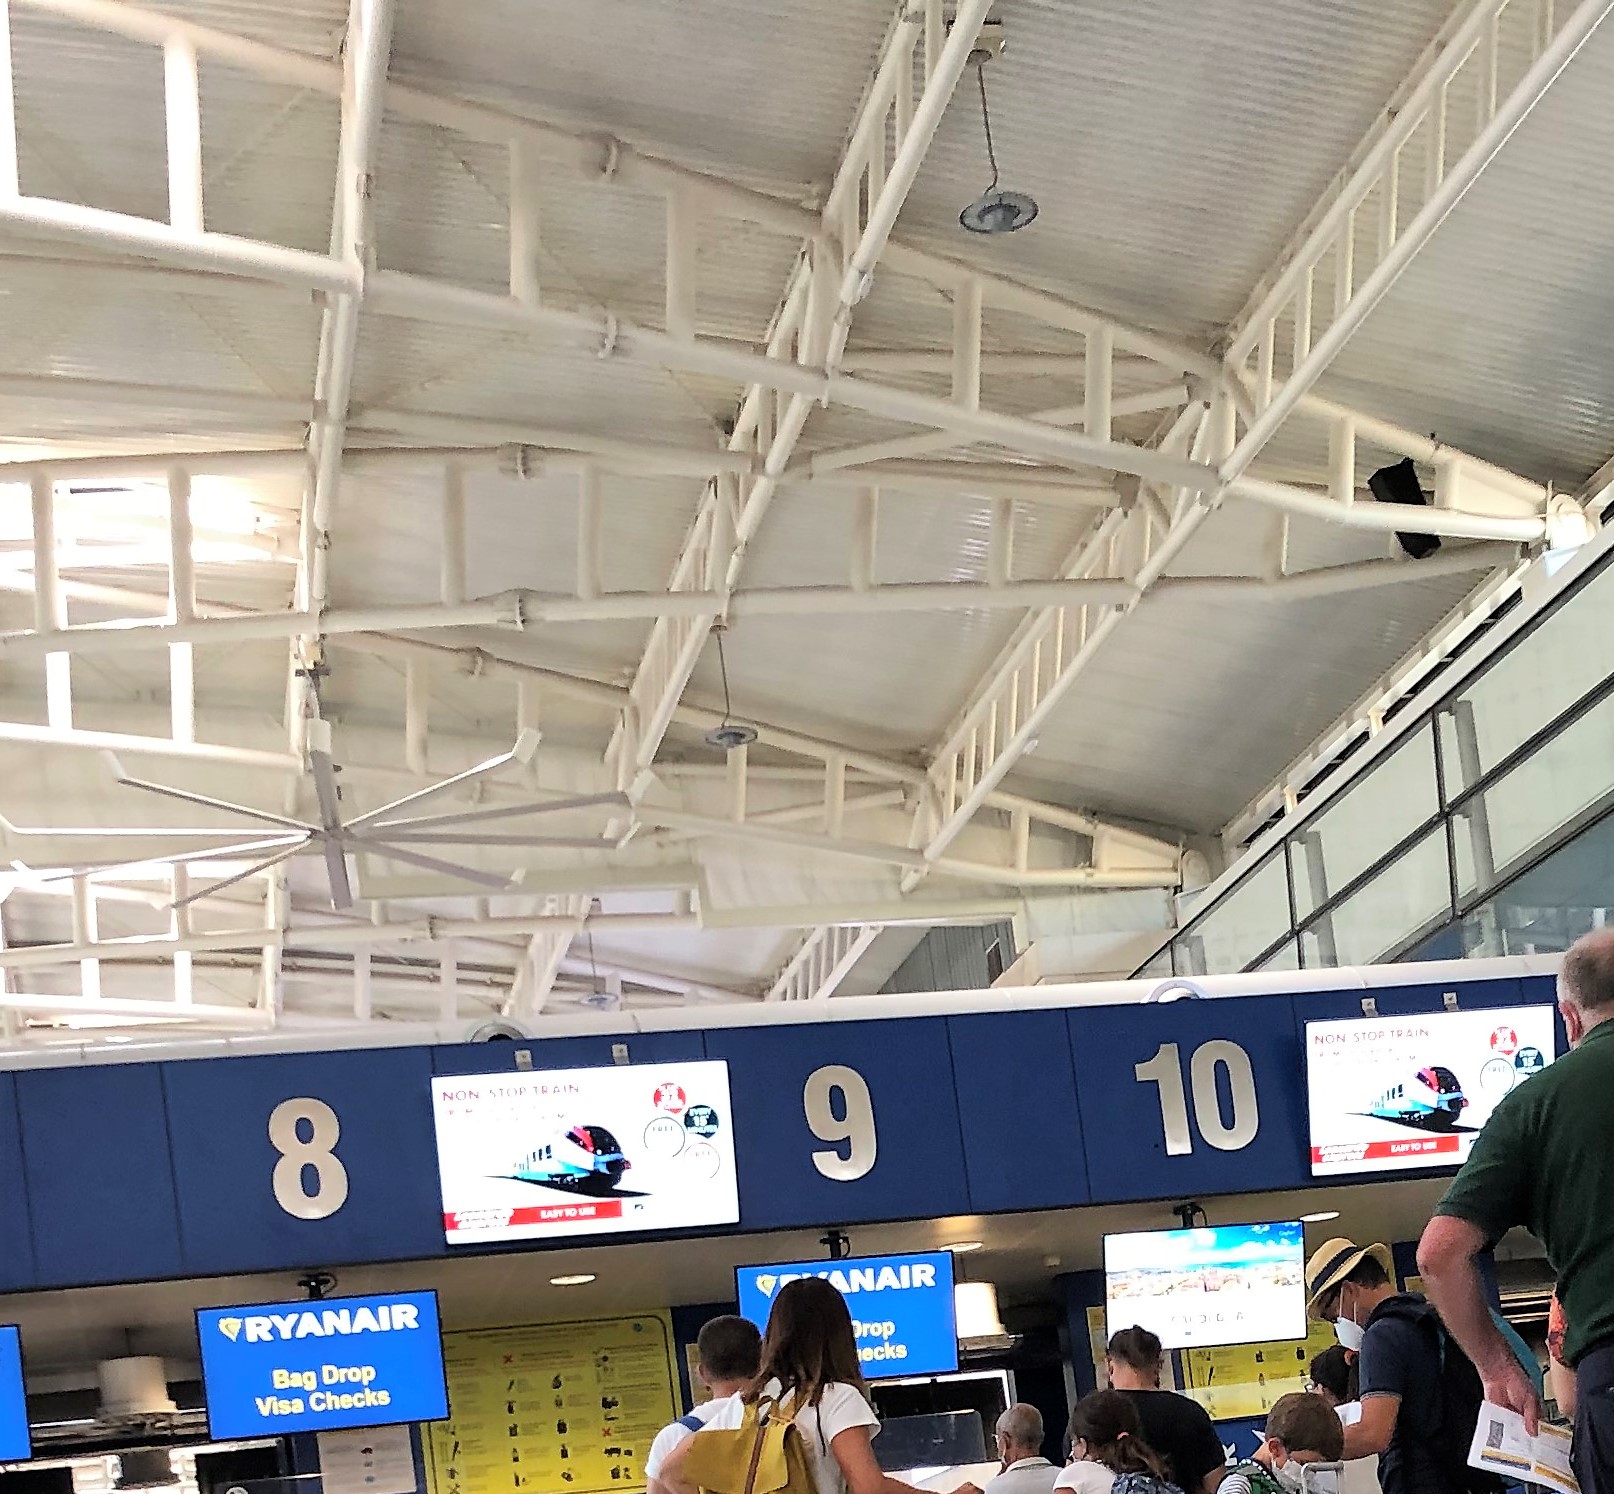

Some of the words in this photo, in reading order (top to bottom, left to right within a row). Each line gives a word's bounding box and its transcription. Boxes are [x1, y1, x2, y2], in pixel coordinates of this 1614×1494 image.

[1314, 1033, 1346, 1045] NON
[1353, 1030, 1385, 1043] STOP
[1390, 1028, 1429, 1039] TRAIN
[442, 1090, 480, 1102] NON
[489, 1086, 527, 1099] STOP
[533, 1083, 580, 1096] TRAIN
[1134, 1039, 1260, 1156] 10
[803, 1064, 879, 1182] 9
[267, 1097, 349, 1221] 8
[779, 1263, 937, 1294] ANAIR
[244, 1303, 420, 1343] RYANAIR
[857, 1342, 908, 1362] ecks
[271, 1368, 318, 1391] Bag
[321, 1364, 376, 1386] Drop
[255, 1395, 305, 1417] Visa
[308, 1387, 391, 1412] Checks
